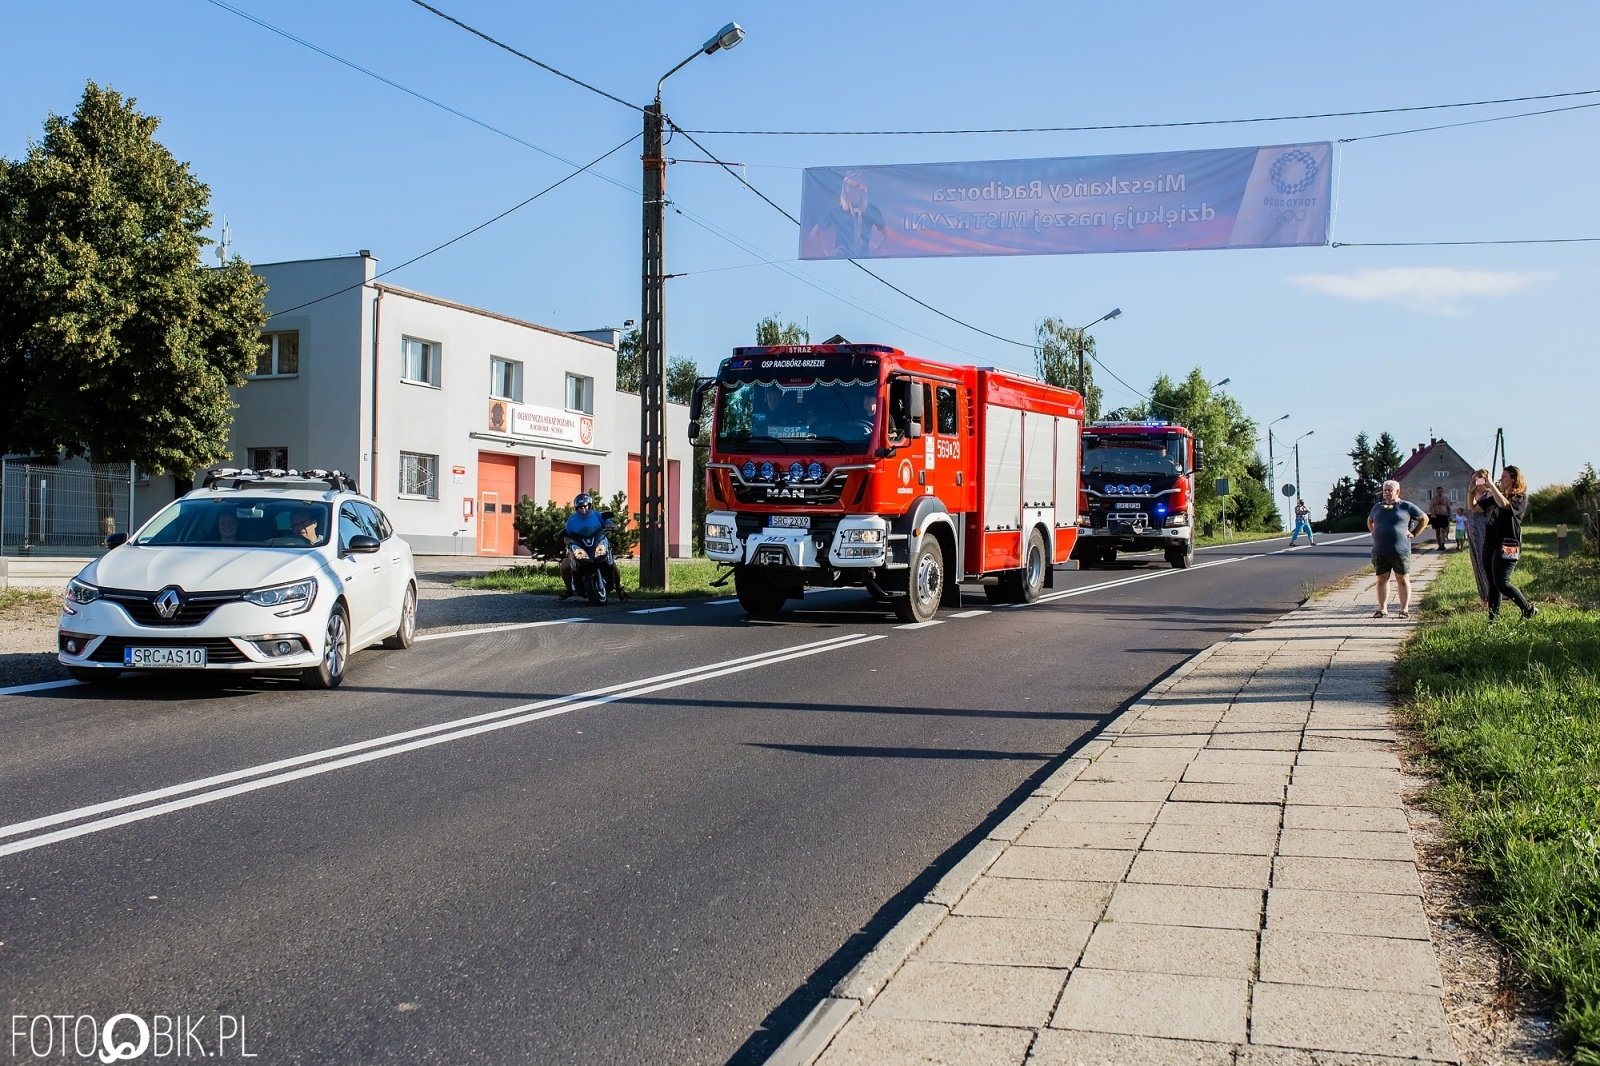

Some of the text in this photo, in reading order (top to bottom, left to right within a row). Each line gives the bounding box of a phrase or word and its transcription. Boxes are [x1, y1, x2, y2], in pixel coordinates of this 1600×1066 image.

[761, 360, 773, 369] OSP
[937, 440, 950, 459] 569
[766, 488, 805, 498] MAN
[773, 516, 809, 526] SRC 2XX9
[134, 649, 202, 664] SRC AS10
